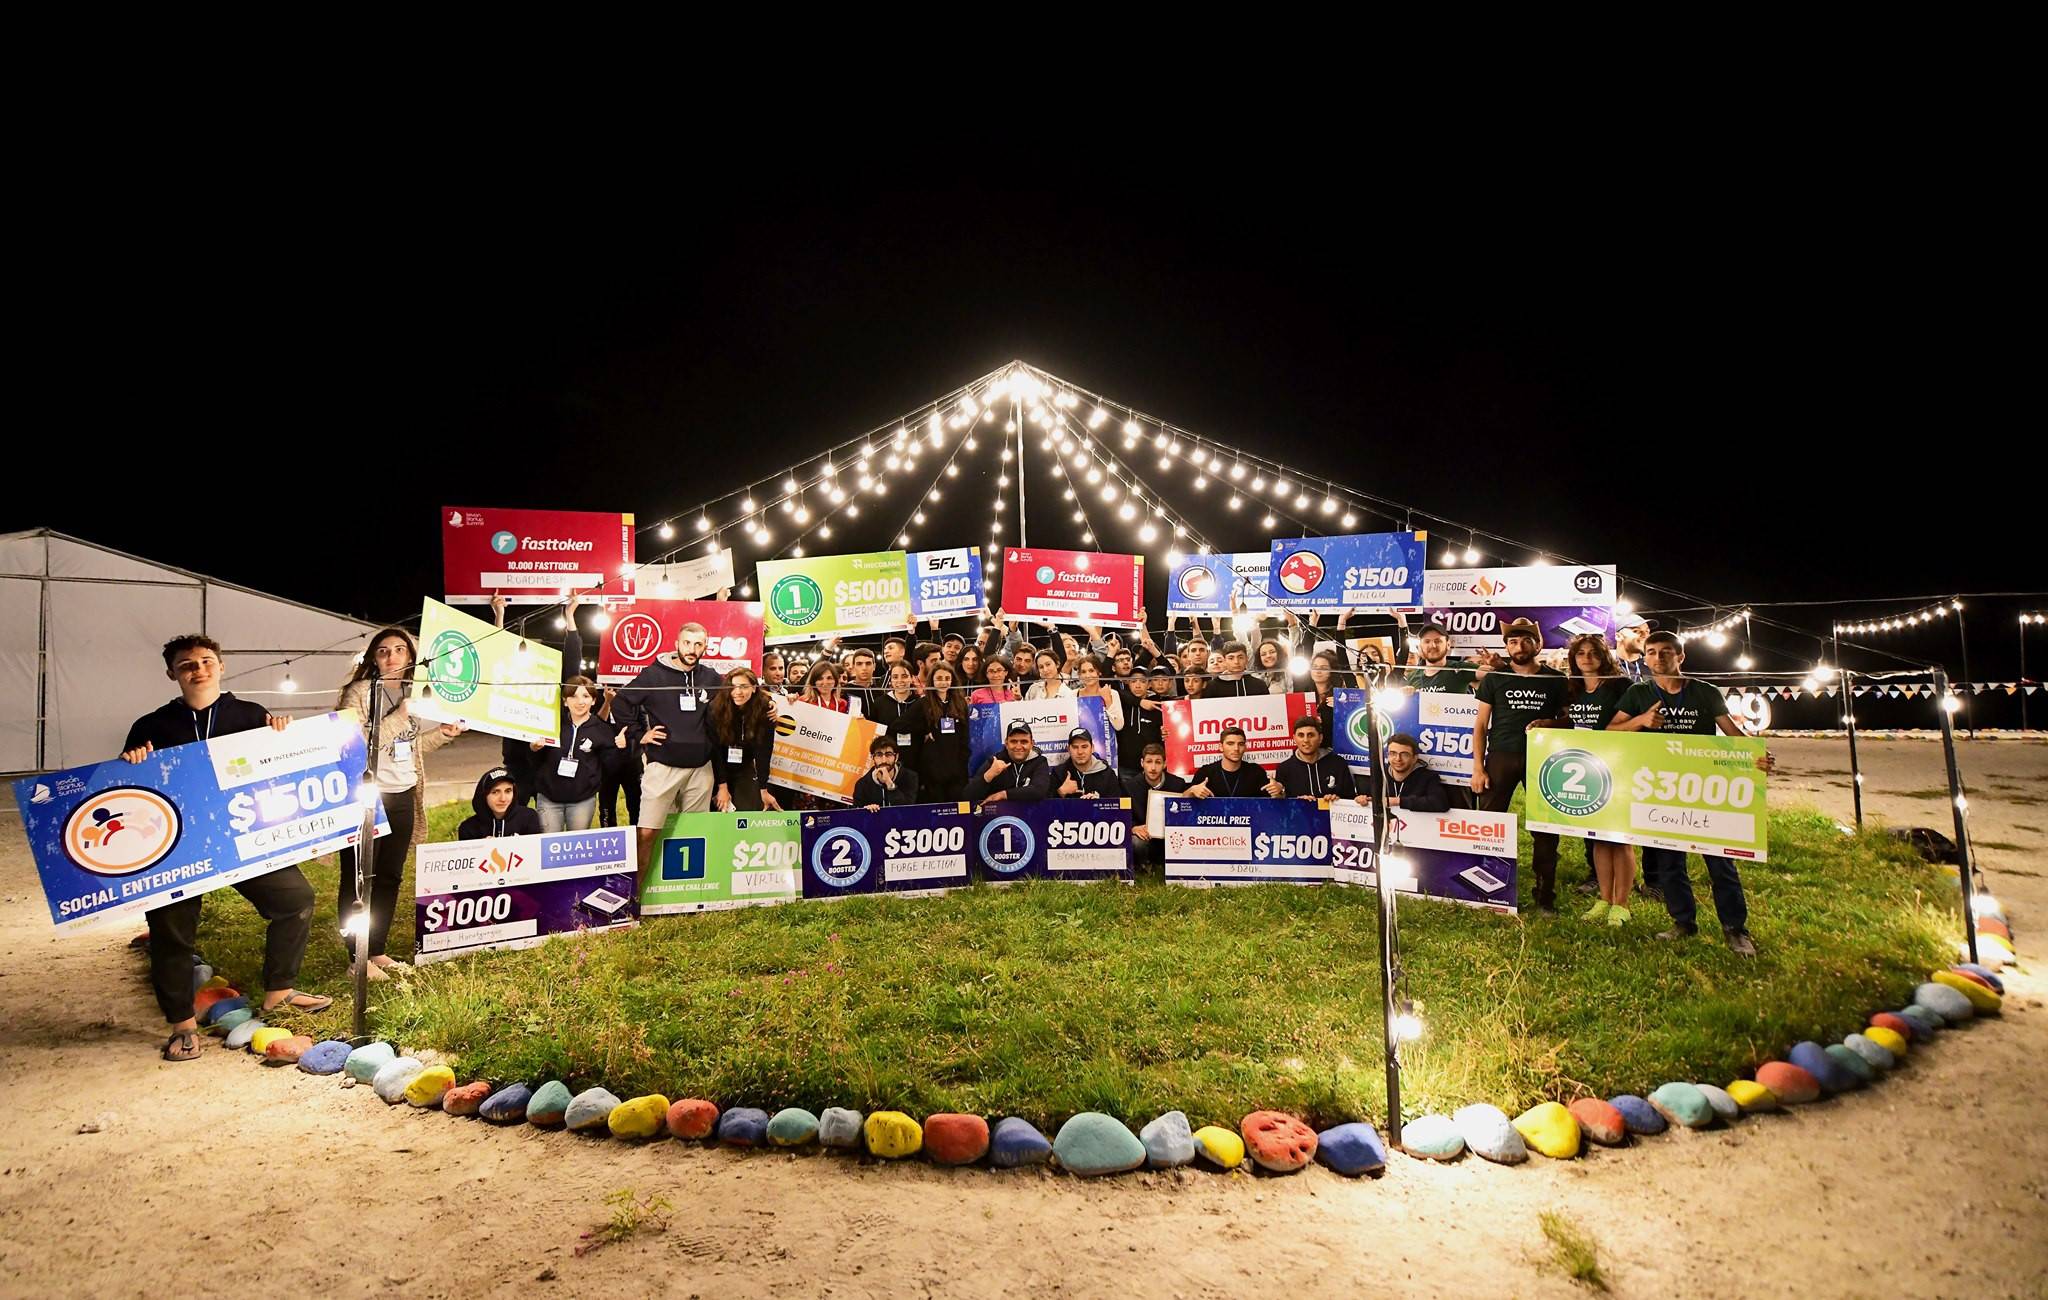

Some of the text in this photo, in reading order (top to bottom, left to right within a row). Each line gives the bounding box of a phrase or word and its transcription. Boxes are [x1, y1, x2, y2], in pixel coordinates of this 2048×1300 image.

[521, 536, 593, 551] fasttoken
[507, 561, 579, 571] 10.000 FASTTOKEN
[929, 557, 960, 571] SFL
[1058, 571, 1111, 585] fasttoken
[1344, 566, 1408, 589] $1500
[1576, 576, 1600, 589] gg
[834, 577, 904, 606] $5000
[920, 577, 971, 600] $1500
[1065, 590, 1099, 599] FASTTOKEN
[1429, 582, 1467, 592] FIRECODE
[789, 585, 801, 608] 1
[1430, 610, 1496, 632] $1000
[445, 643, 464, 676] 3
[800, 726, 833, 743] Beeline
[1187, 743, 1206, 752] PIZZA
[1252, 740, 1266, 748] FOR
[1685, 748, 1754, 760] INECOBANK
[259, 757, 272, 766] SEF
[790, 761, 825, 777] FICTION
[1562, 763, 1586, 792] 2
[1632, 767, 1754, 808] $3000
[227, 770, 348, 833] $1500
[1546, 795, 1603, 815] BY INECOBANK
[1568, 793, 1591, 801] BATTLE
[1197, 816, 1251, 825] SPECIAL PRIZE
[1332, 813, 1368, 824] FIRECODE
[1648, 808, 1710, 828] CowNet
[1047, 819, 1126, 847] $5000
[1437, 817, 1506, 838] Telcell
[549, 837, 619, 854] QUALITY
[885, 827, 964, 857] $3000
[1000, 827, 1012, 853] 1
[1188, 836, 1247, 846] SmartClick
[1254, 832, 1329, 860] $1500
[549, 849, 620, 862] TESTING LAB
[679, 846, 690, 871] 1
[831, 839, 851, 867] 2
[424, 857, 476, 873] FIRECODE
[594, 862, 627, 872] SPECIAL PRIZE
[828, 866, 856, 874] BOOSTER
[891, 859, 958, 873] FORGE FICTION
[59, 858, 213, 916] SOCIAL ENTERPRISE
[646, 882, 720, 893] AMERIABANK CHALLENGE
[424, 893, 512, 931] $1000
